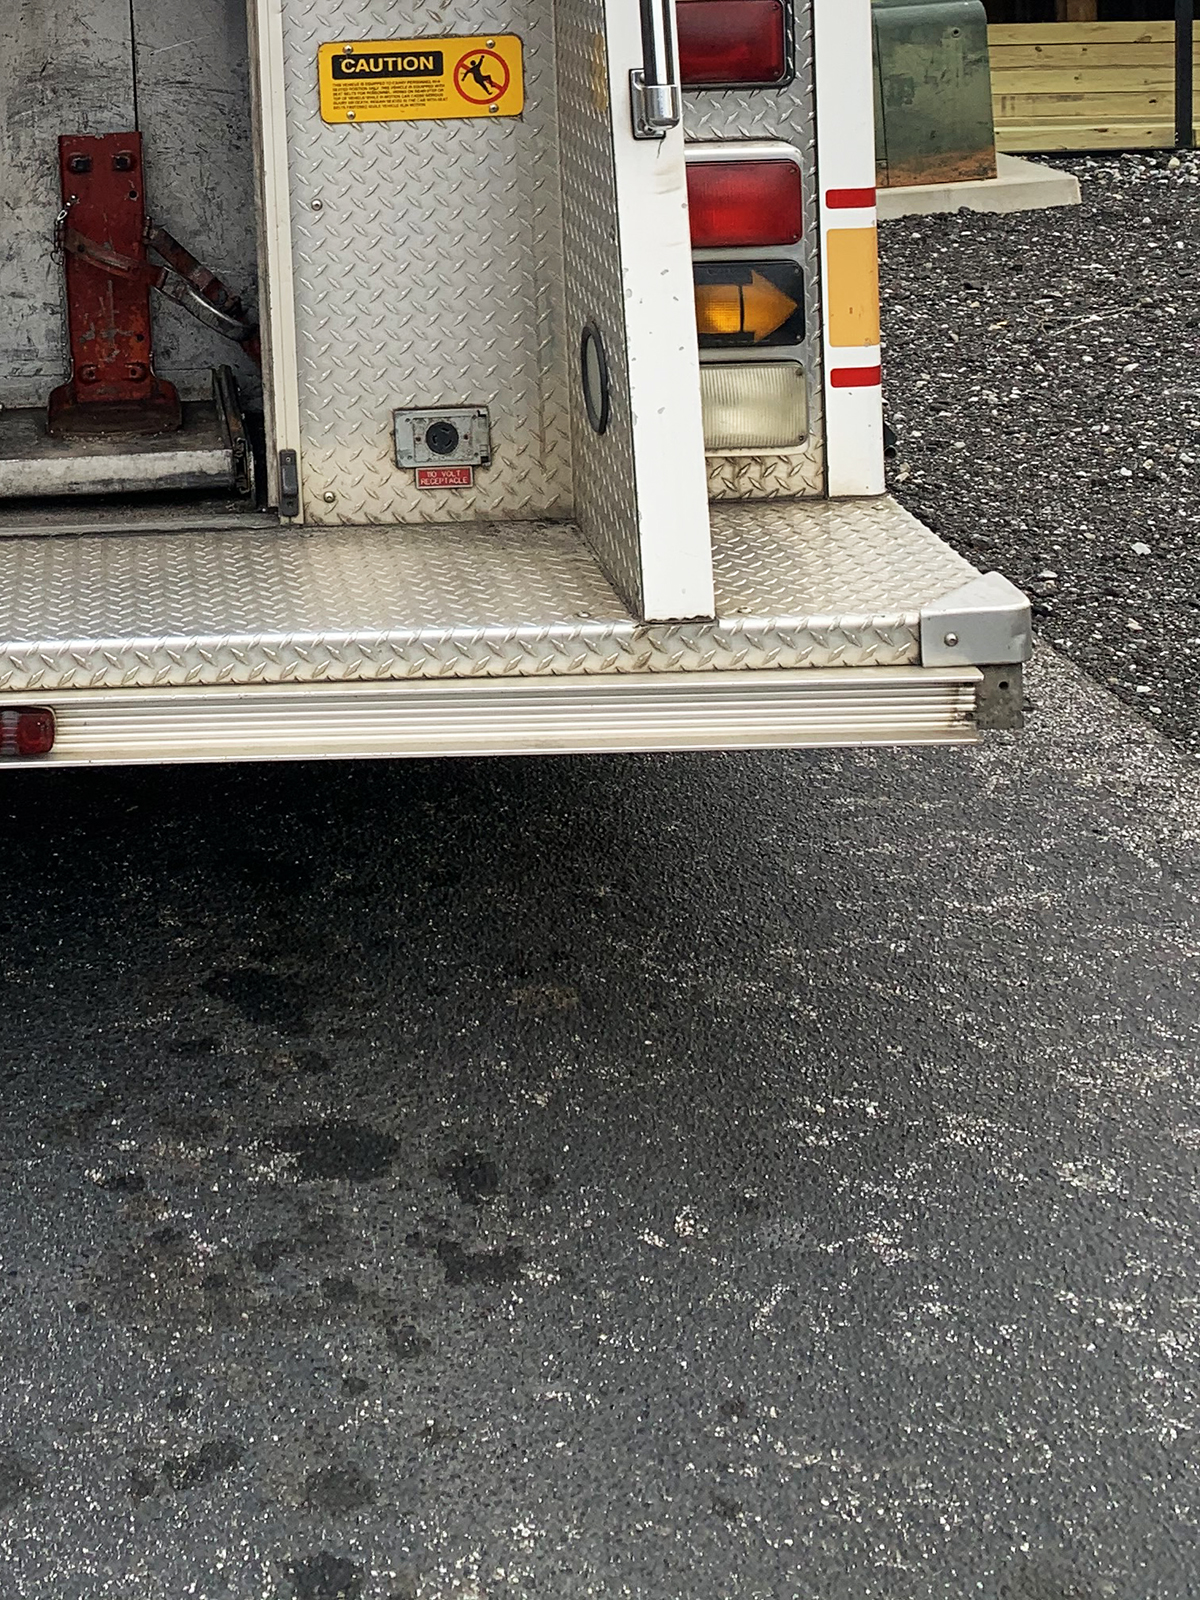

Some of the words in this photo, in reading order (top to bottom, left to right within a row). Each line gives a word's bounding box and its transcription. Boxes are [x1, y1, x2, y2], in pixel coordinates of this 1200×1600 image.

[341, 56, 434, 73] CAUTION
[441, 469, 461, 477] VOLT
[420, 476, 469, 485] RECEPTACLE
